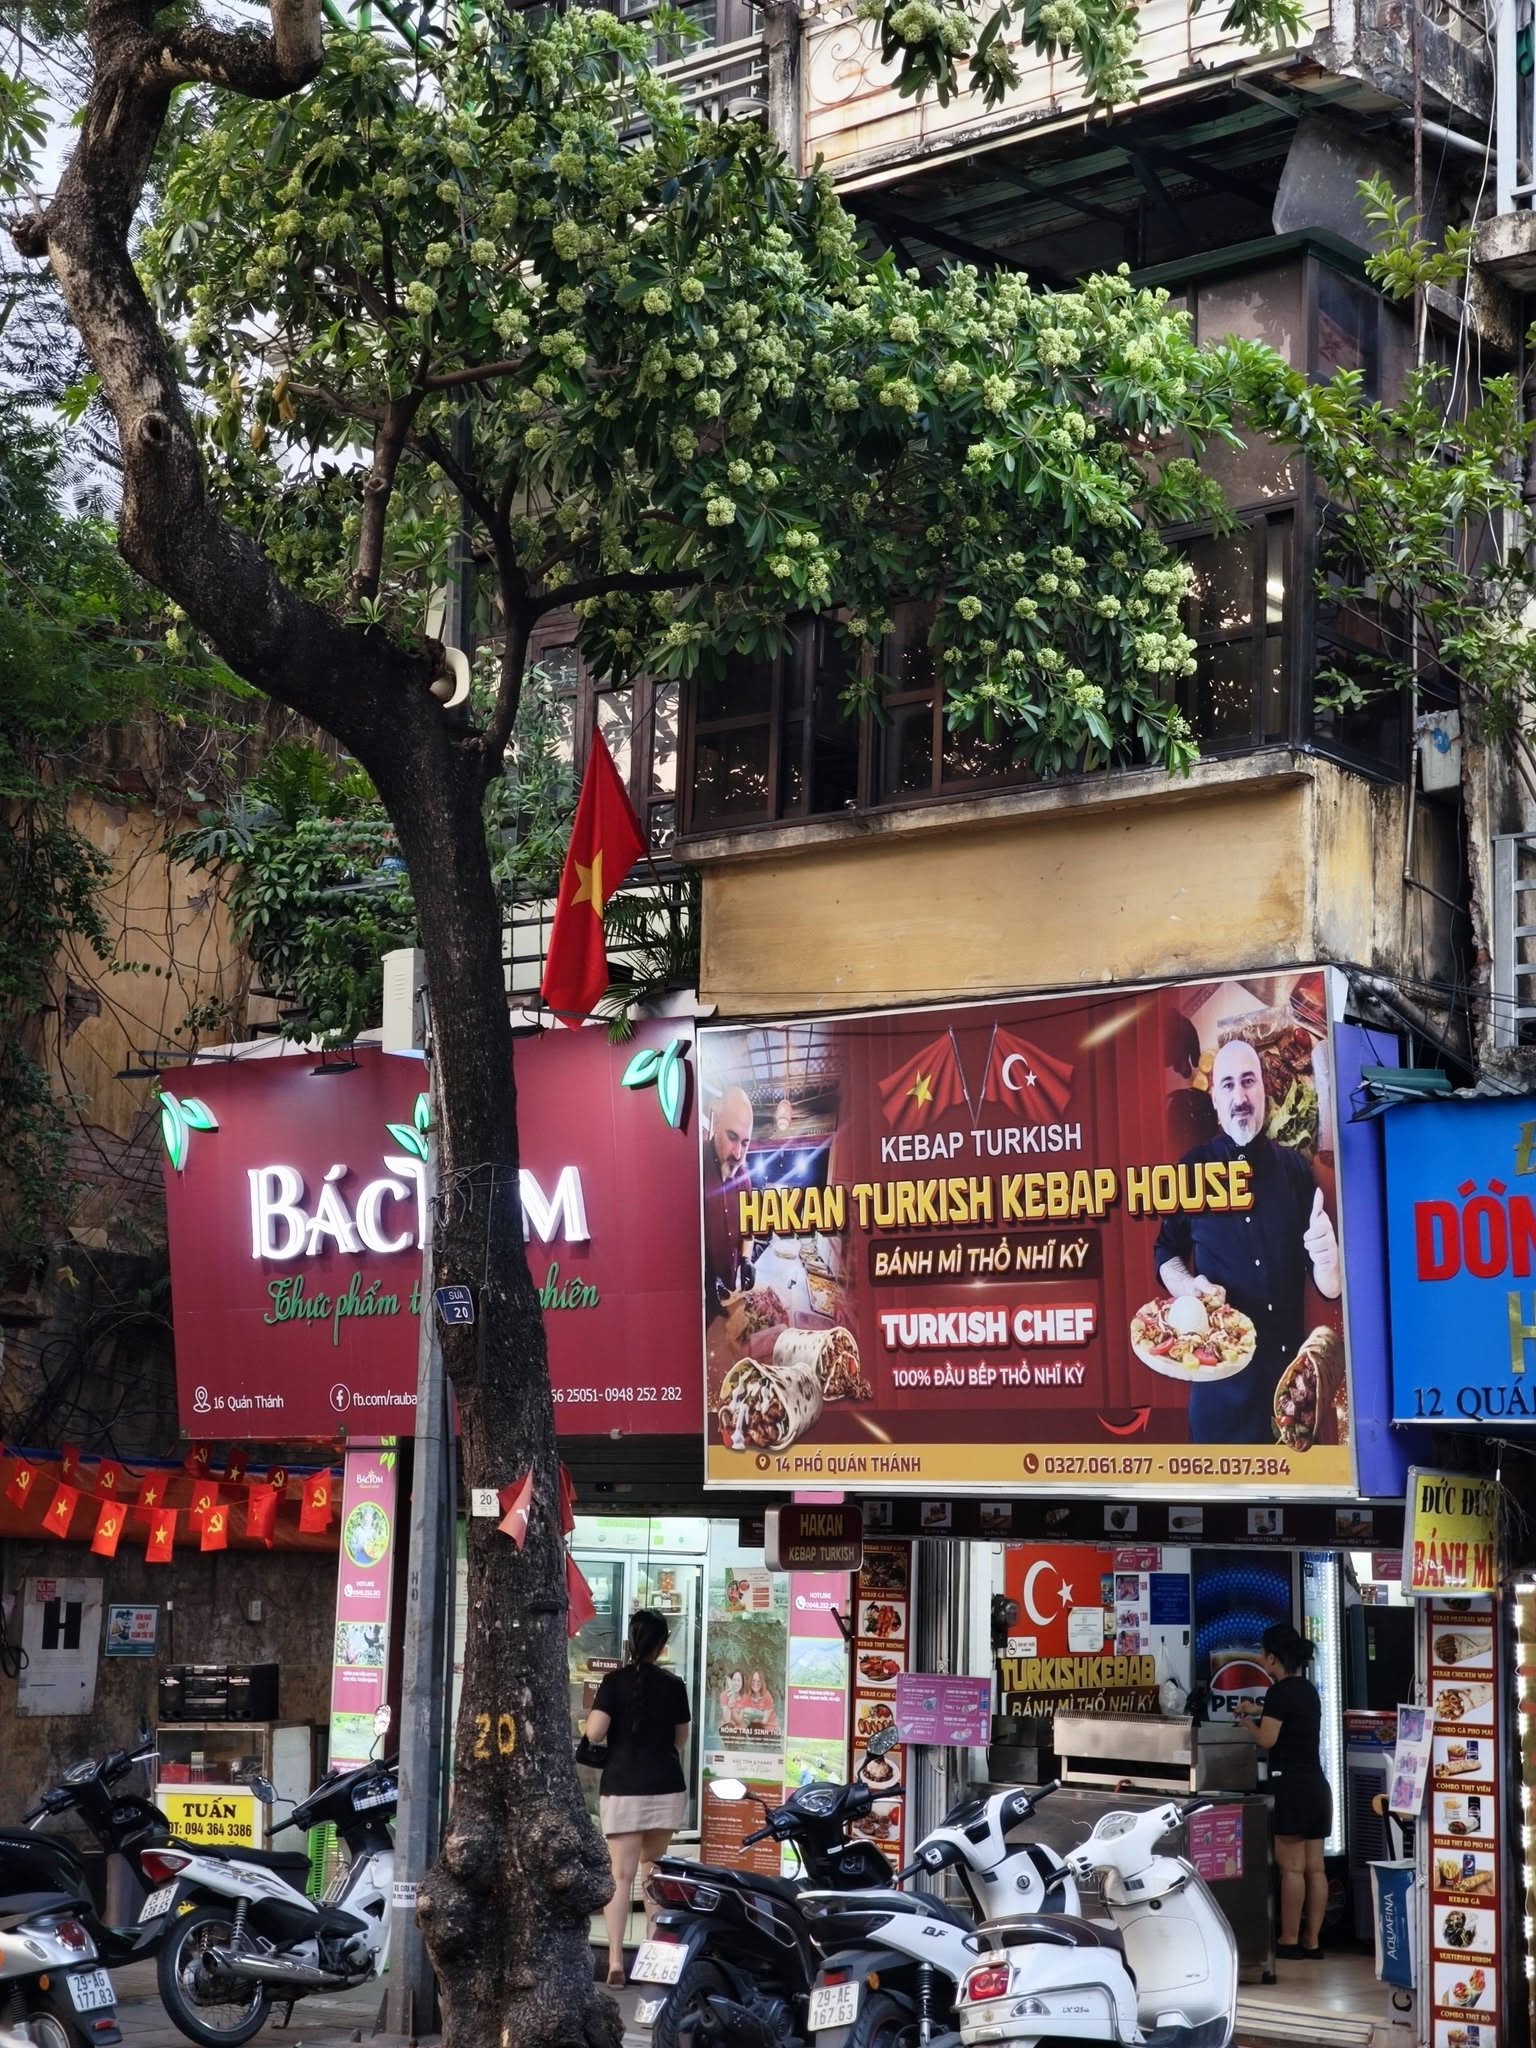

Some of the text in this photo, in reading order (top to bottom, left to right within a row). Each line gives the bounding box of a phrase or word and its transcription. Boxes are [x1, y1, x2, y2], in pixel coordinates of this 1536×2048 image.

[880, 1123, 1083, 1163] KEBAP TURKISH
[737, 1158, 1255, 1235] HAKAN TURKISH KEBAP HOUSE
[875, 1233, 1089, 1276] BÁNH MÌ THỔ NHĨ KỲ
[264, 1274, 332, 1326] Thực
[332, 1271, 400, 1346] phẩm
[408, 1279, 423, 1315] t
[454, 1306, 468, 1318] 20
[880, 1305, 1095, 1348] TURKISH CHEF
[892, 1358, 1085, 1387] 100% ĐẦU BẾP THỔ NHĨ KỲ
[214, 1395, 284, 1411] 16 Quán Thánh
[353, 1390, 418, 1406] fb.com/rauba
[637, 1387, 657, 1401] 252
[661, 1386, 682, 1401] 282
[1414, 1375, 1536, 1421] 12 QUÁ
[775, 1450, 921, 1474] 14 PHỐ QUÁN THÁNH
[1044, 1456, 1152, 1475] 0327.061.877
[1168, 1457, 1291, 1476] 0962.037.384
[480, 1494, 492, 1505] 20
[800, 1513, 844, 1537] HAKAN
[789, 1546, 855, 1561] KEBAP TURKISH
[1412, 1527, 1495, 1589] BÁNH MÌ
[1011, 1696, 1053, 1717] BÁNH
[1211, 1695, 1266, 1713] PEP
[473, 1713, 516, 1760] 20
[182, 1797, 237, 1818] TUẤN
[185, 1822, 203, 1835] 094
[207, 1823, 224, 1836] 364
[227, 1824, 252, 1837] 3386
[1383, 1891, 1399, 1961] AQUAFINA
[74, 1971, 106, 1992] 29-AG
[77, 1988, 114, 2009] 177.83
[817, 1985, 852, 2008] 29-AE
[813, 2003, 854, 2027] 167.63
[1440, 2009, 1464, 2019] COMBO
